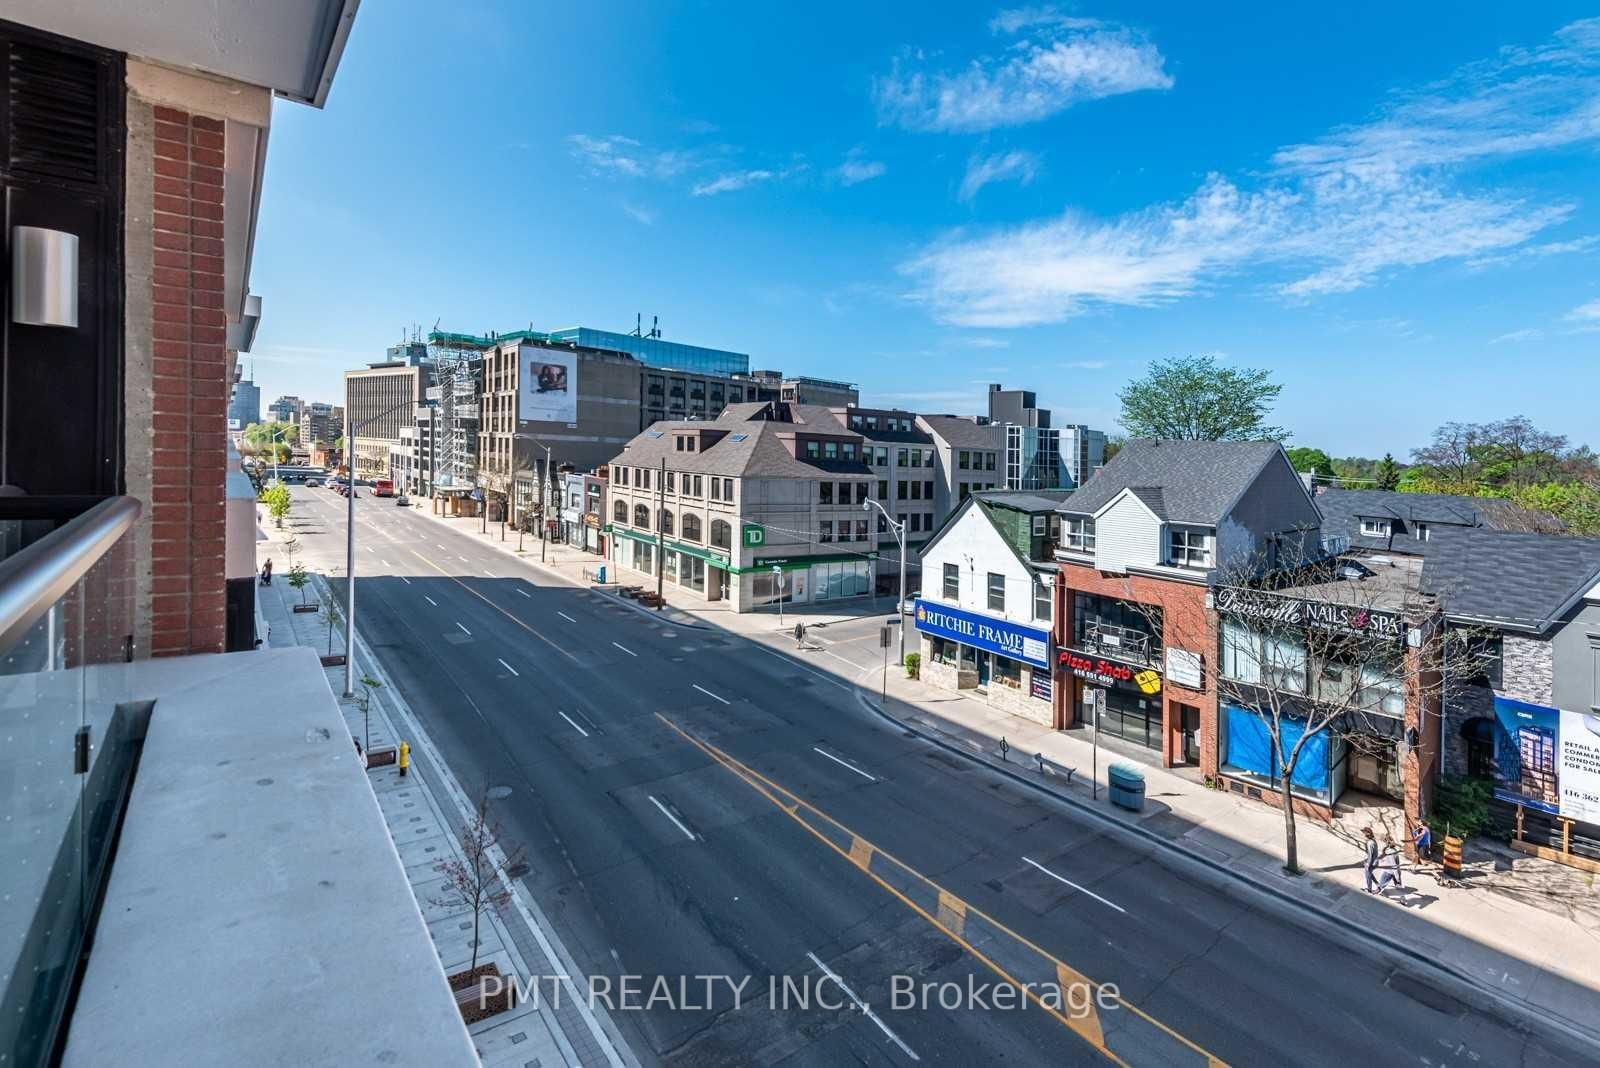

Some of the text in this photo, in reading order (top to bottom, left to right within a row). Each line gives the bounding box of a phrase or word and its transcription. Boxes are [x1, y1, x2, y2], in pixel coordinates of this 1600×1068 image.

[747, 530, 762, 543] TD
[926, 610, 975, 636] RITCHIE
[978, 624, 1023, 650] FRAME
[1306, 603, 1348, 625] NAILS
[1370, 614, 1398, 634] SPA
[1058, 651, 1131, 680] Pizza Shab
[1564, 741, 1591, 751] RETAIL
